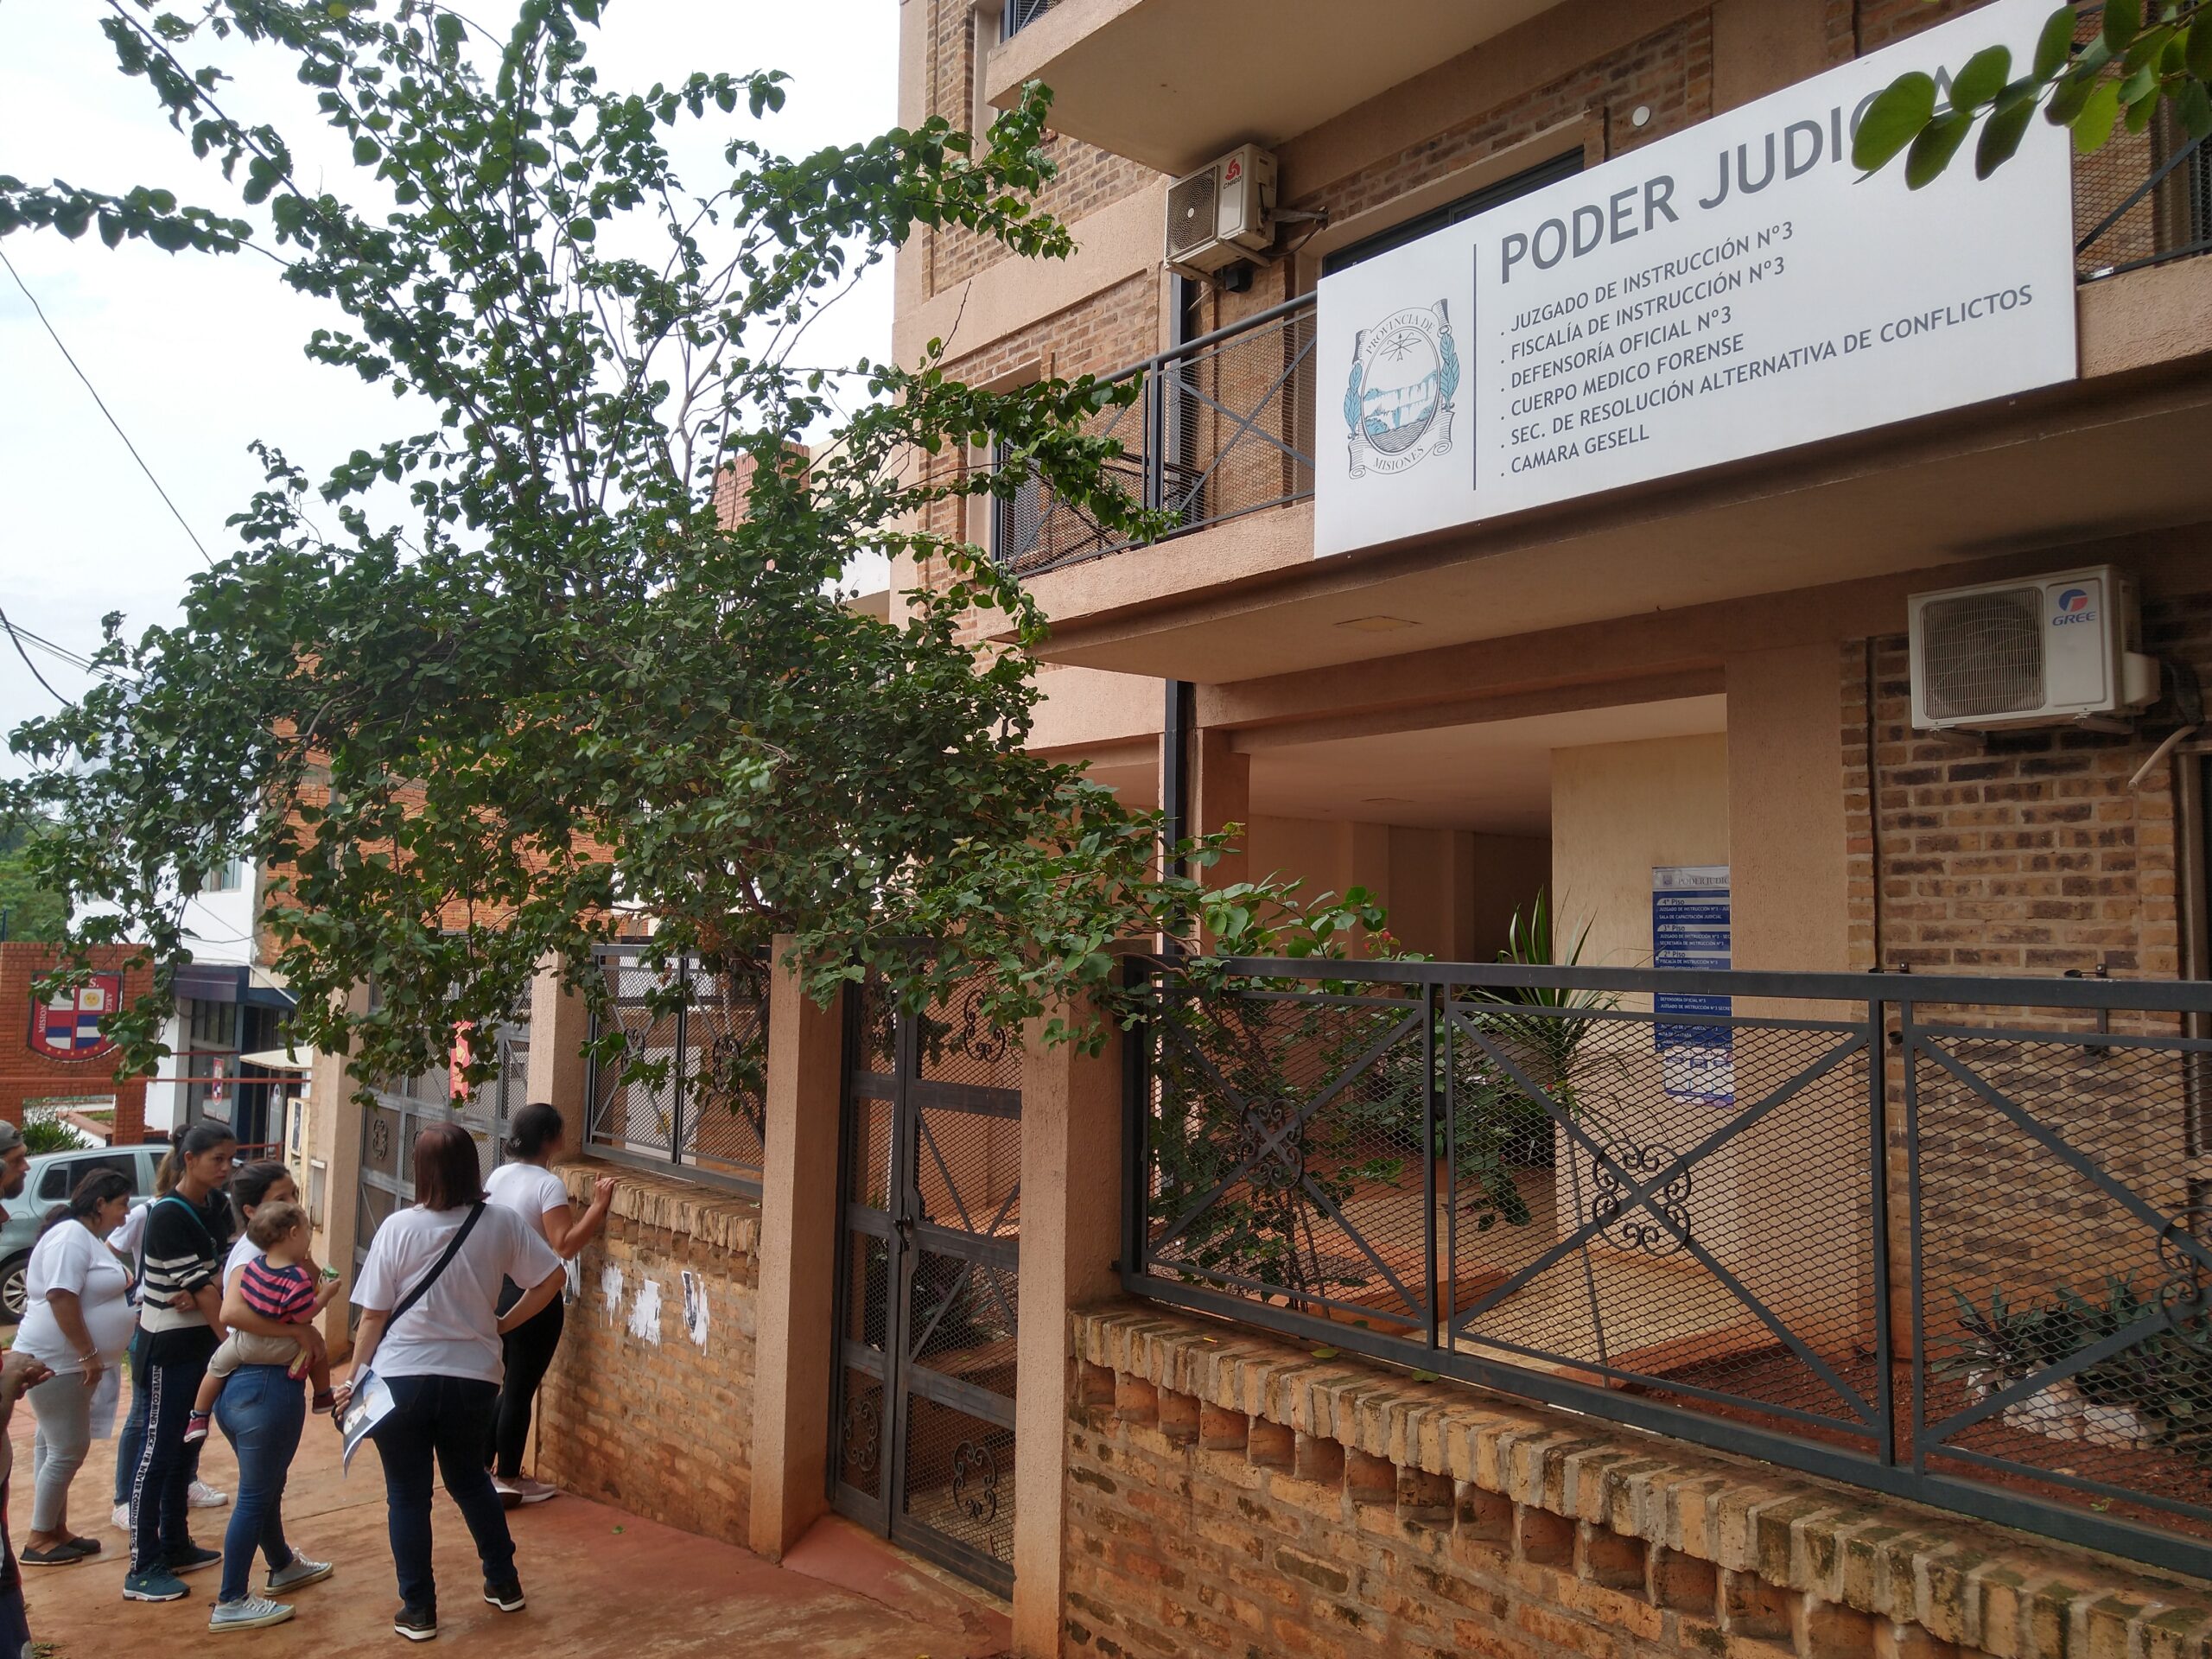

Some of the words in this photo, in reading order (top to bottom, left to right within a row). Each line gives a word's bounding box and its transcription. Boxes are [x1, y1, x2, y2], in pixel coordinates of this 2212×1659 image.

[1502, 175, 1679, 284] PODER
[1510, 292, 1589, 332] JUZGADO
[1596, 282, 1618, 304] DE
[1624, 236, 1750, 295] INSTRUCCIÓN
[1365, 314, 1418, 354] PROVINCIA
[1421, 317, 1435, 334] DE
[1511, 322, 1583, 360] FISCALÍA
[1588, 314, 1610, 336] DE
[1617, 270, 1741, 326] INSTRUCCIÓN
[1511, 341, 1614, 388] DEFENSORÍA
[1619, 320, 1691, 354] OFICIAL
[1511, 423, 1546, 445] SEC.
[1553, 414, 1574, 434] DE
[1580, 380, 1694, 426] RESOLUCIÓN
[1700, 340, 1837, 394] ALTERNATIVA
[1844, 329, 1872, 353] DE
[1880, 284, 2032, 343] CONFLICTOS
[1511, 384, 1577, 416] CUERPO
[1583, 362, 1650, 397] MEDICO
[1657, 334, 1744, 374] FORENSE
[1373, 445, 1424, 471] MISIONES
[1511, 442, 1580, 474] CAMARA
[1585, 424, 1649, 454] GESELL
[2052, 611, 2096, 626] GREE
[1678, 877, 1704, 886] PODER
[150, 1393, 161, 1426] COMING
[135, 1465, 147, 1490] NEVER
[131, 1492, 141, 1525] COMING
